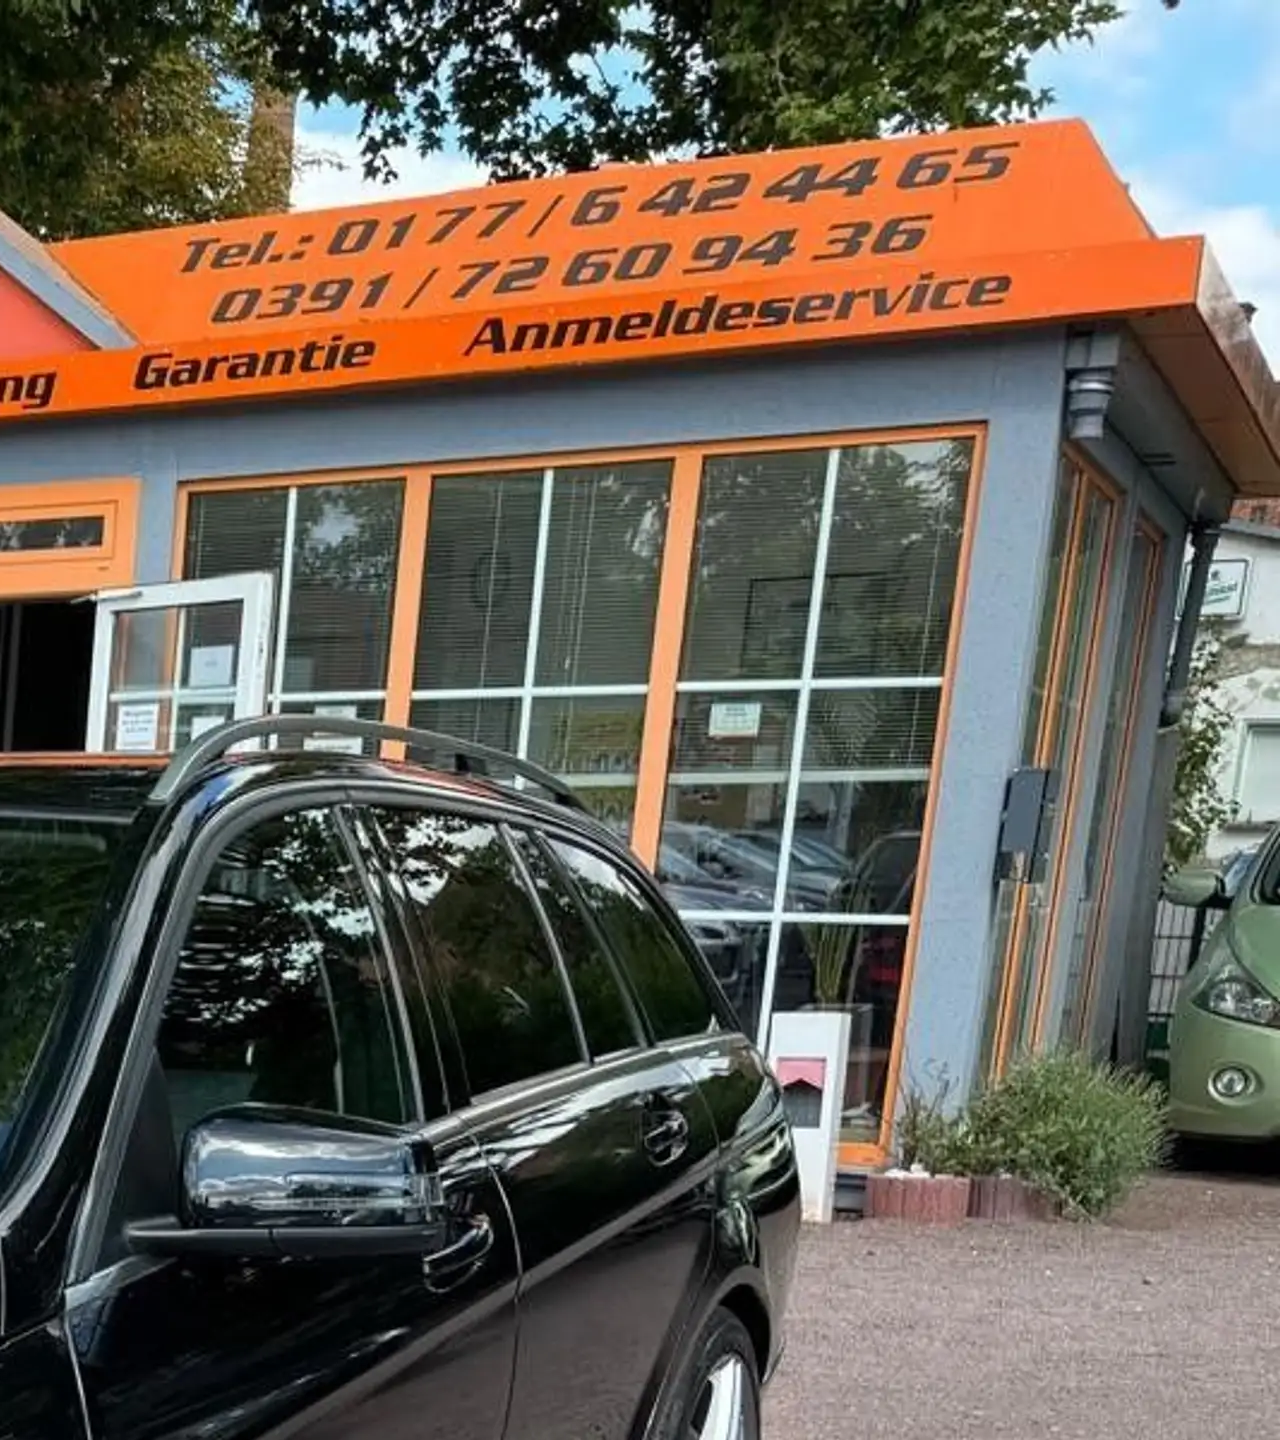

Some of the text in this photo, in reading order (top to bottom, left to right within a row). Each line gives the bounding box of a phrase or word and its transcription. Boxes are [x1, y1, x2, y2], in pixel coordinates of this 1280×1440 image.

[180, 231, 315, 274] Tel.:
[327, 200, 525, 256] 0177
[637, 172, 751, 218] 42
[762, 156, 881, 204] 44
[895, 140, 1020, 190] 65
[210, 272, 394, 325] 0391
[452, 255, 551, 300] 72
[561, 241, 673, 288] 60
[681, 226, 799, 276] 94
[810, 213, 934, 261] 36
[463, 270, 1013, 357] Anmeldeservice
[133, 333, 376, 391] Garantie
